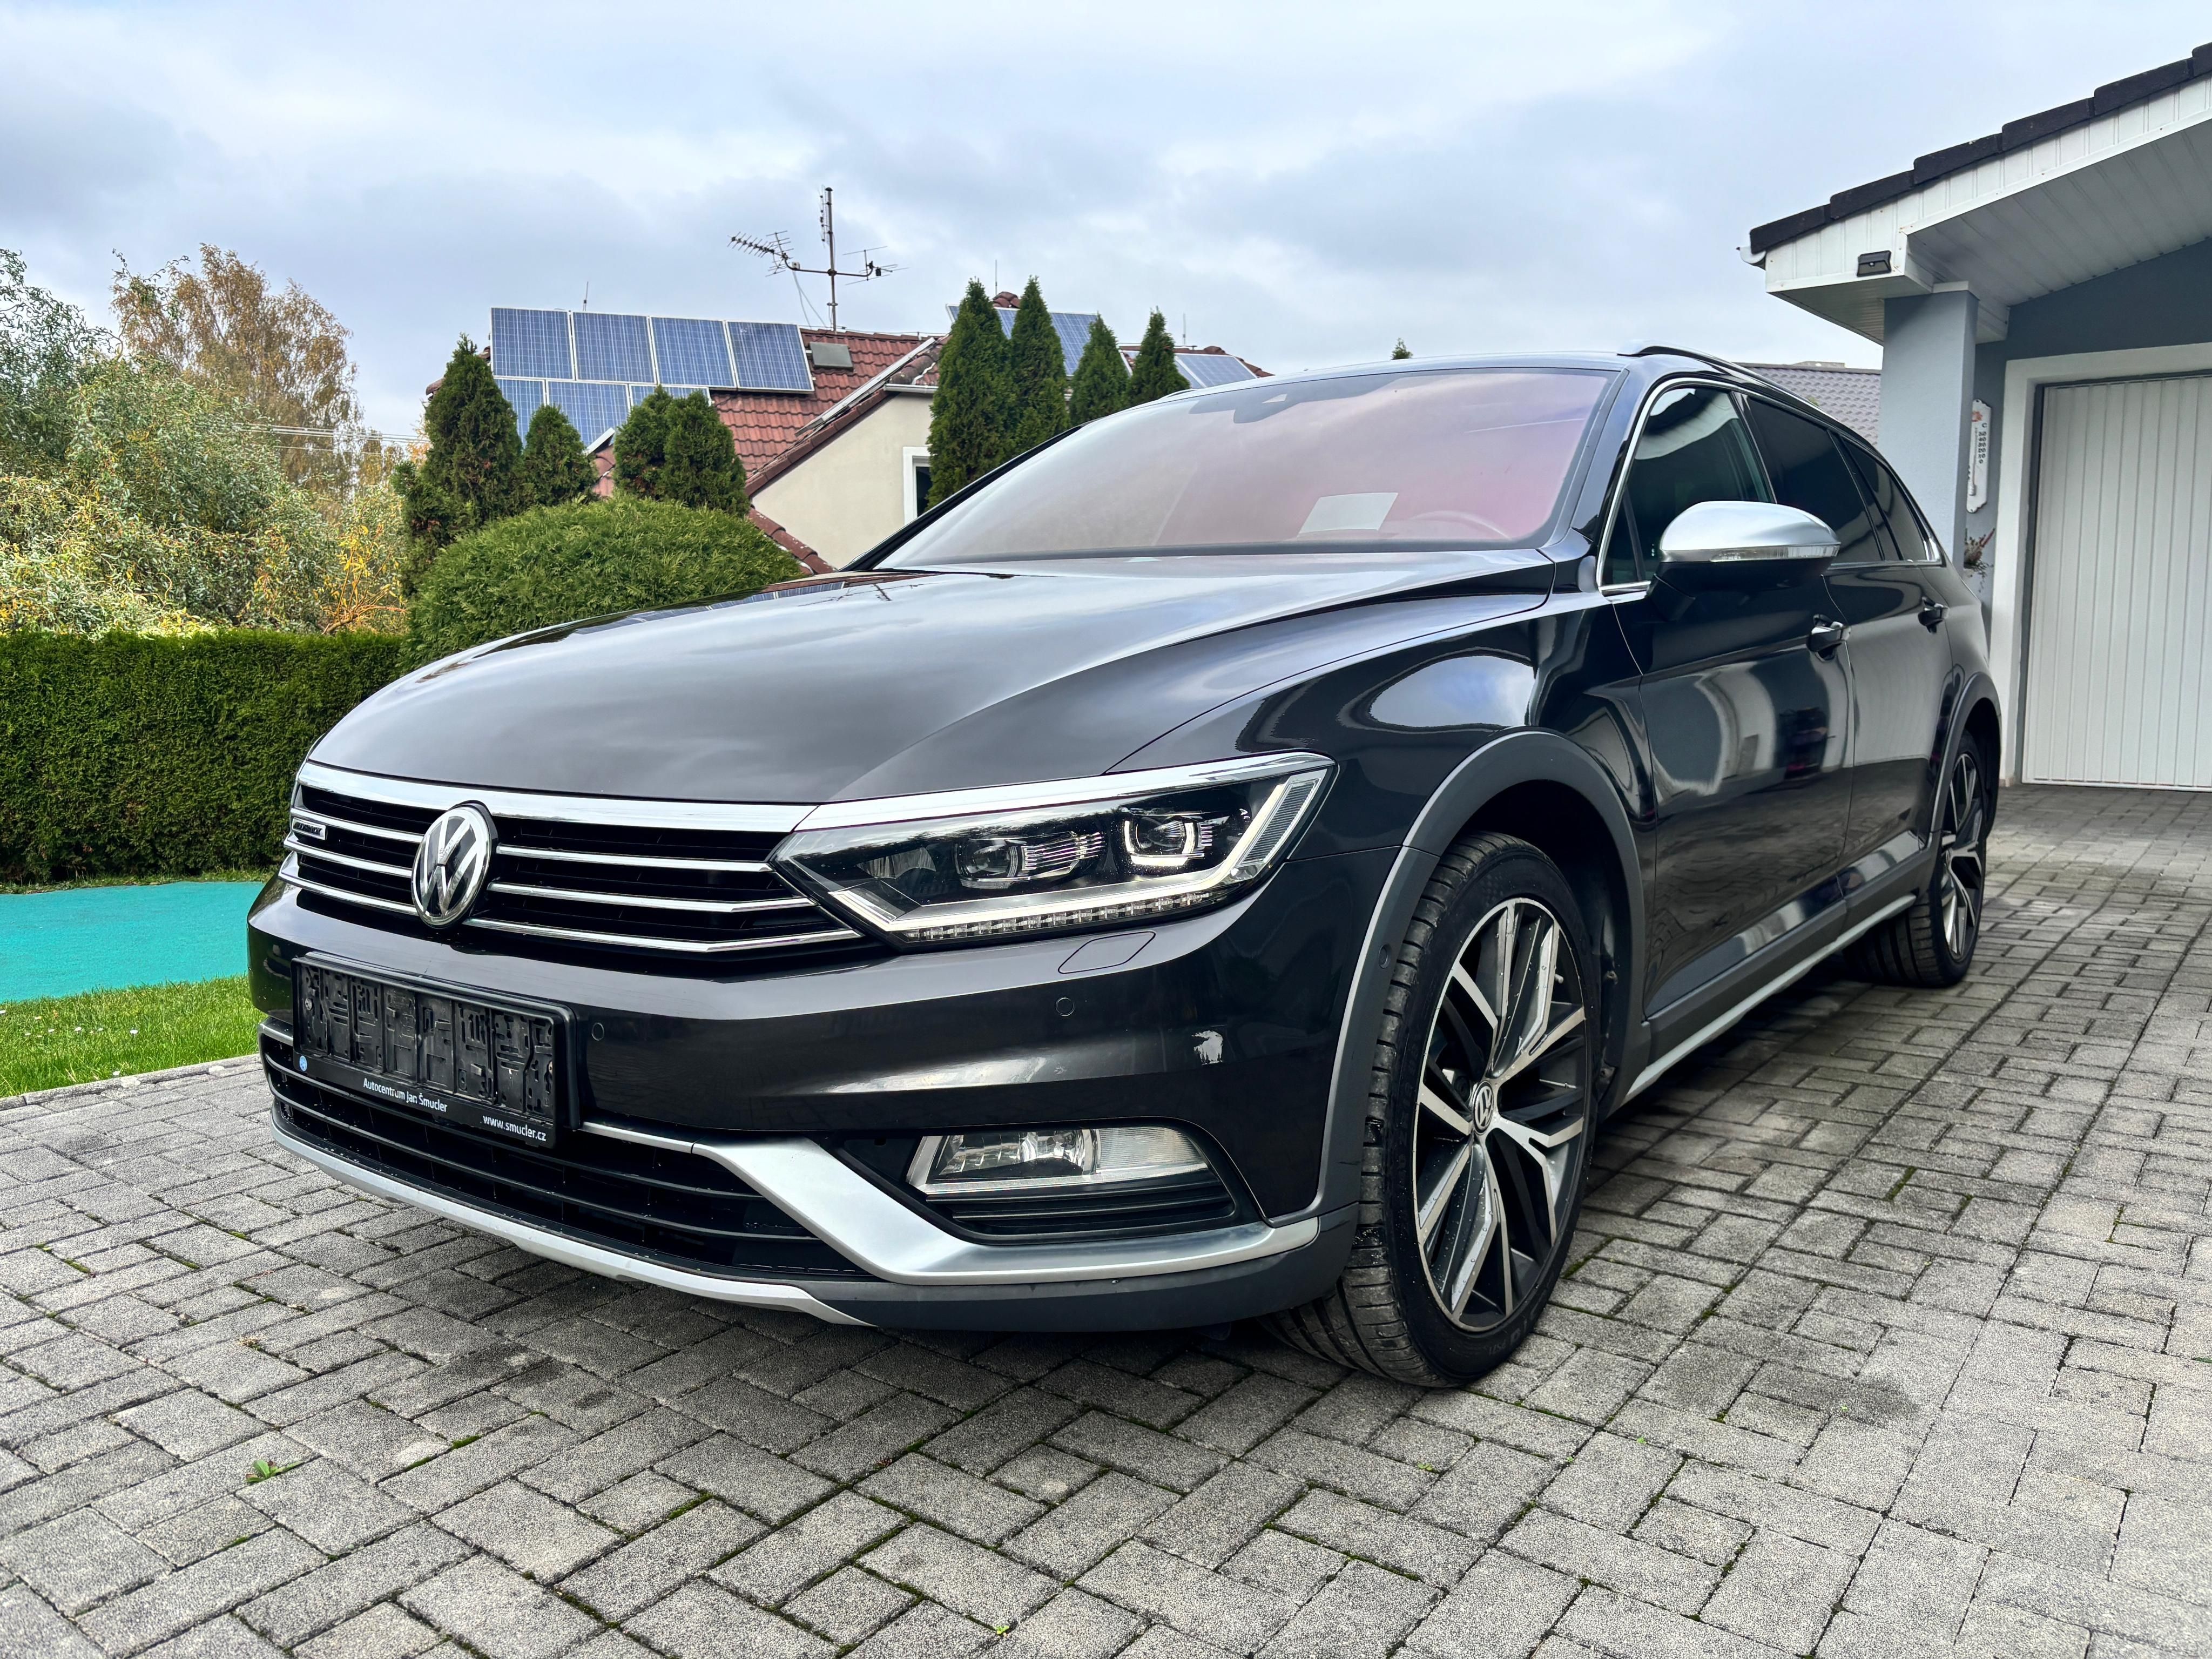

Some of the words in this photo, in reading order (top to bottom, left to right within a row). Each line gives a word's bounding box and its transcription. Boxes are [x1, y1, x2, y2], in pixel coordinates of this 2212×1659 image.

[363, 1077, 405, 1100] Autocentrum
[406, 1091, 417, 1103] Jan
[419, 1092, 448, 1112] Šmucler
[483, 1115, 547, 1142] www.smucler.cz
